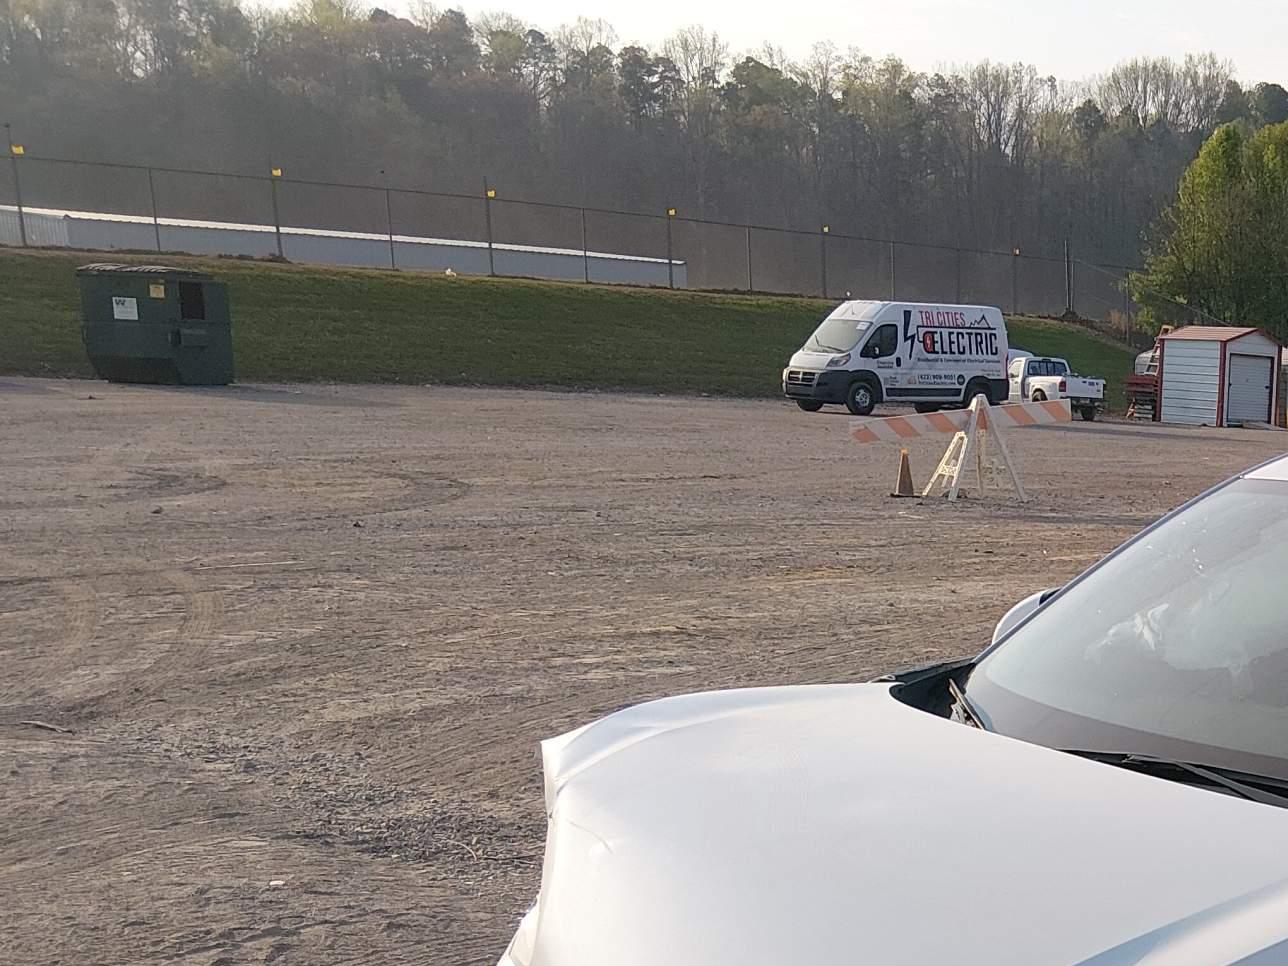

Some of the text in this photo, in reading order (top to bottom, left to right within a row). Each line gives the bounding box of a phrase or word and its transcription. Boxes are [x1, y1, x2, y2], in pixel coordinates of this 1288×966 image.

[918, 310, 966, 328] TRI CITIES
[923, 331, 999, 356] ELECTRIC
